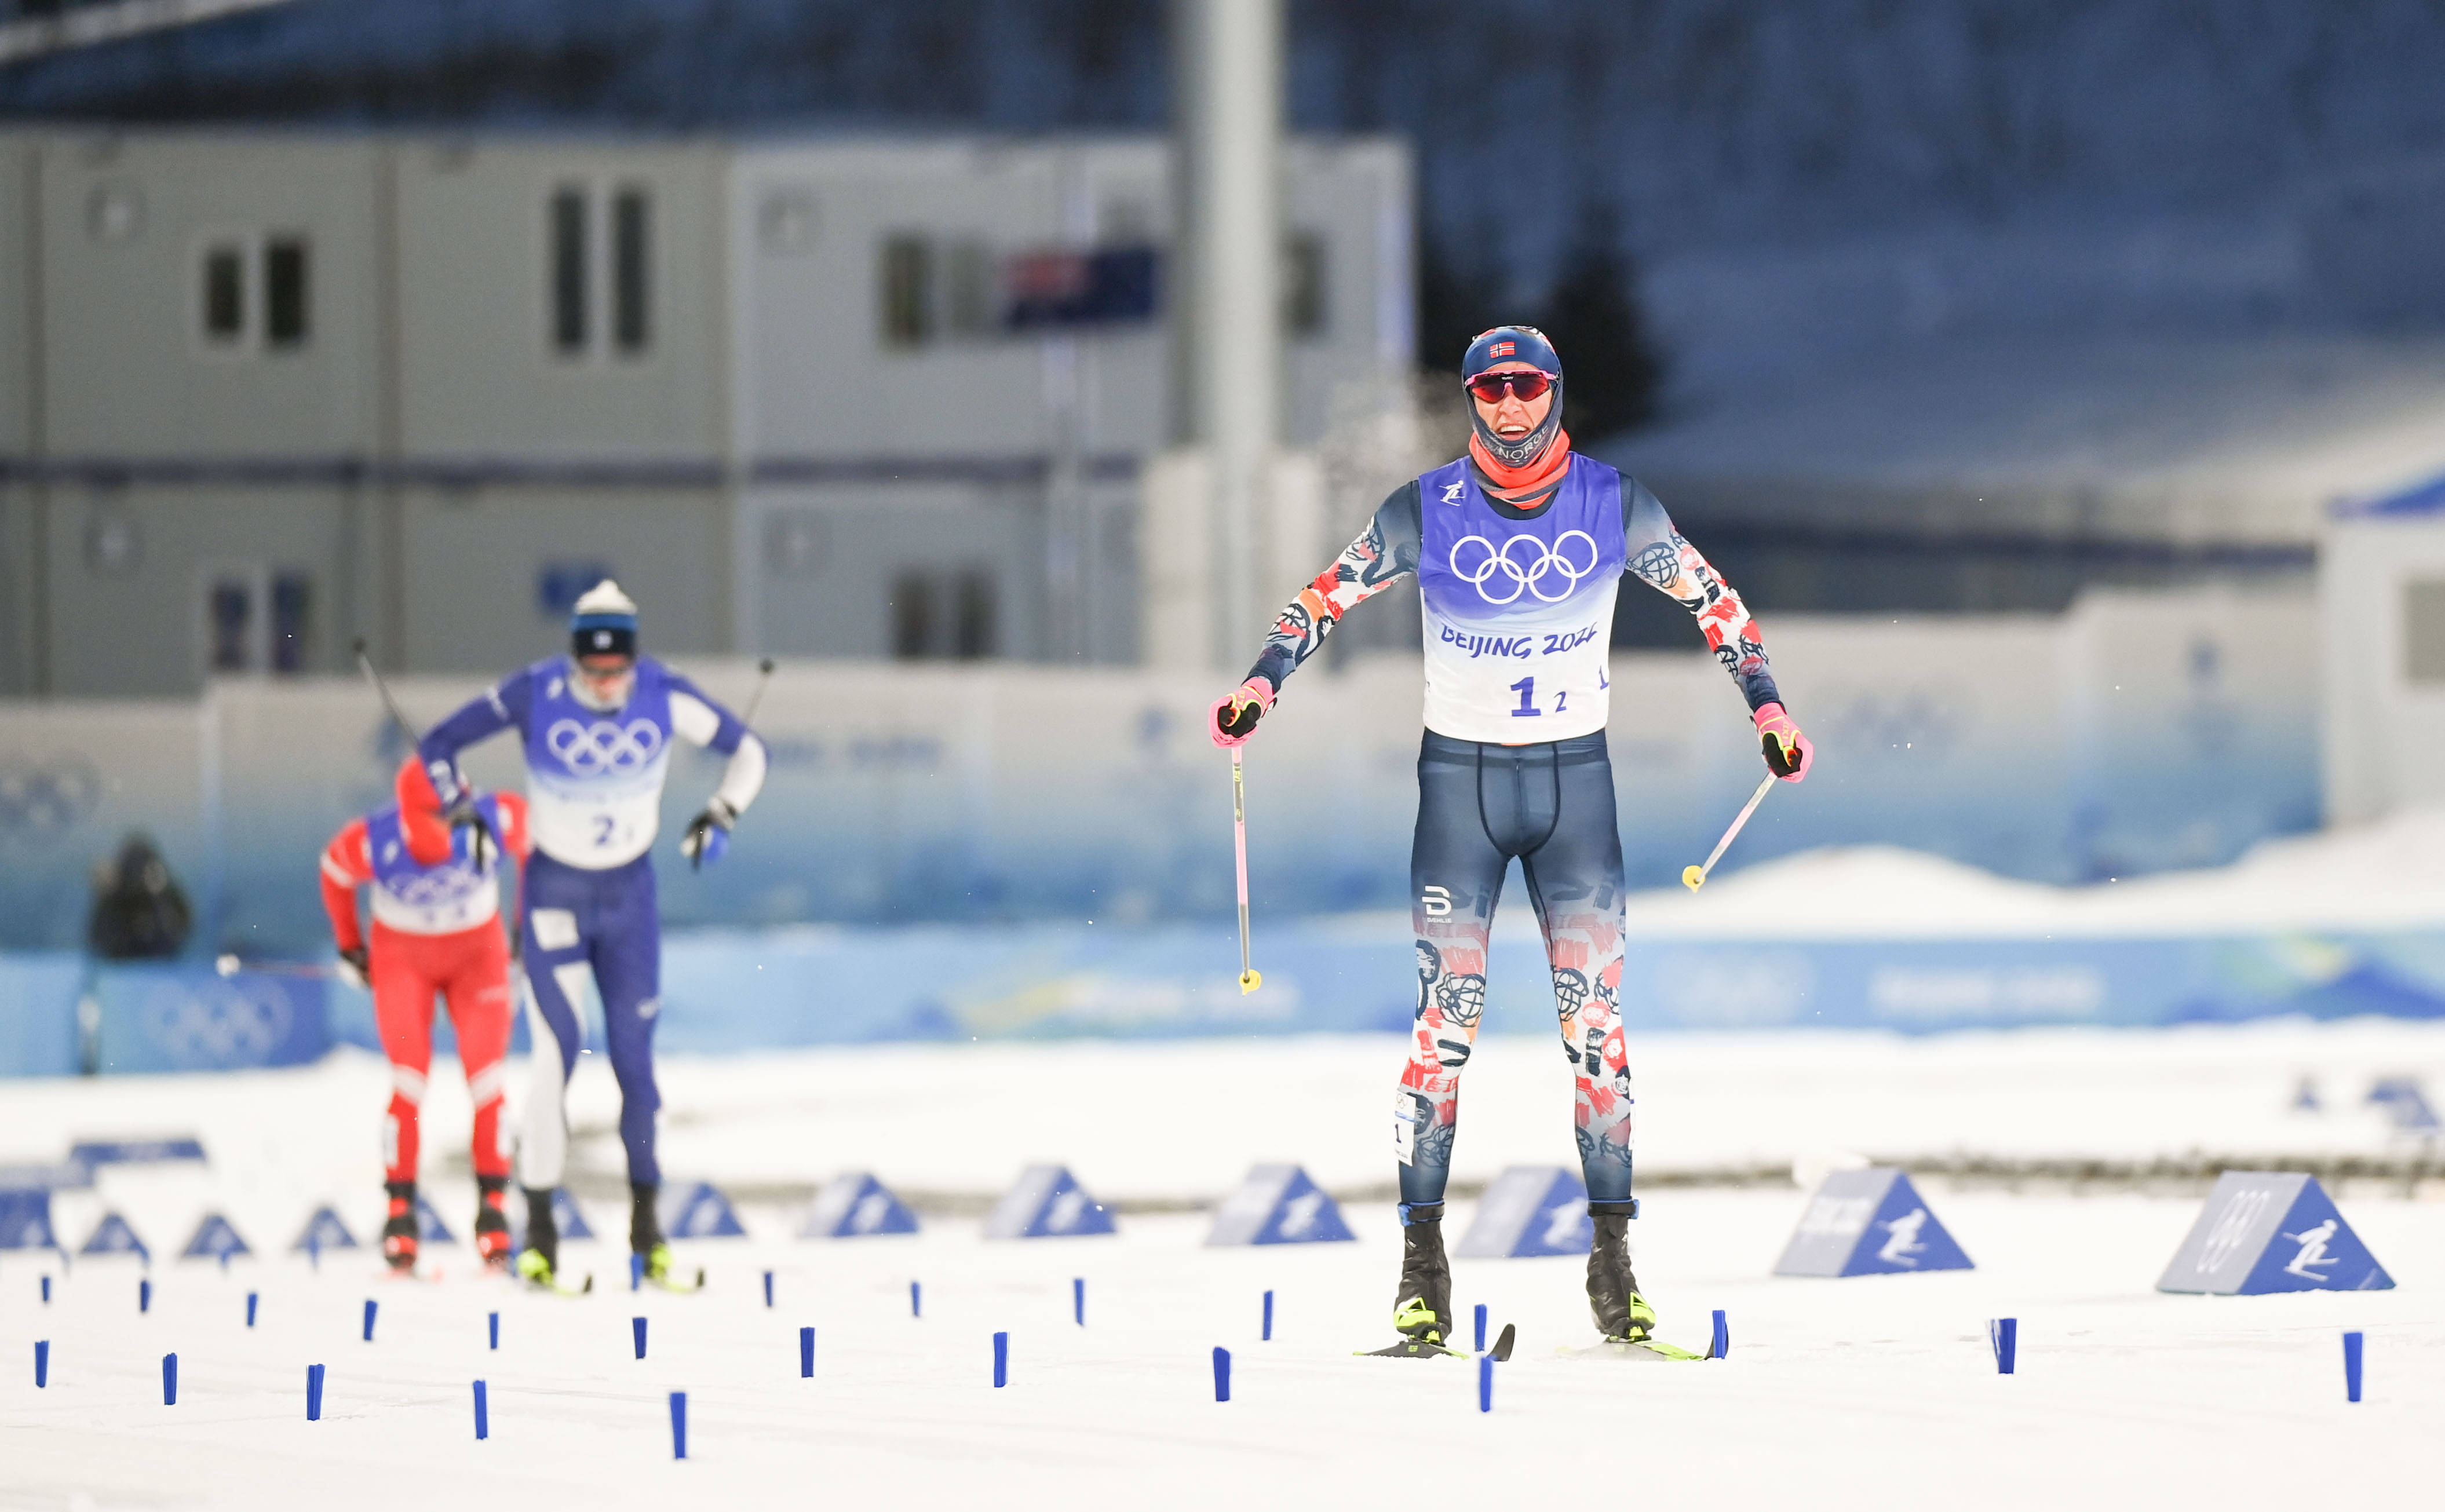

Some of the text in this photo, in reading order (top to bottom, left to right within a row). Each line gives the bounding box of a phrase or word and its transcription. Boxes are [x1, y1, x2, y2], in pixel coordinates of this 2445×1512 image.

[1441, 623, 1532, 659] BEIJING
[1510, 676, 1567, 717] 1 2
